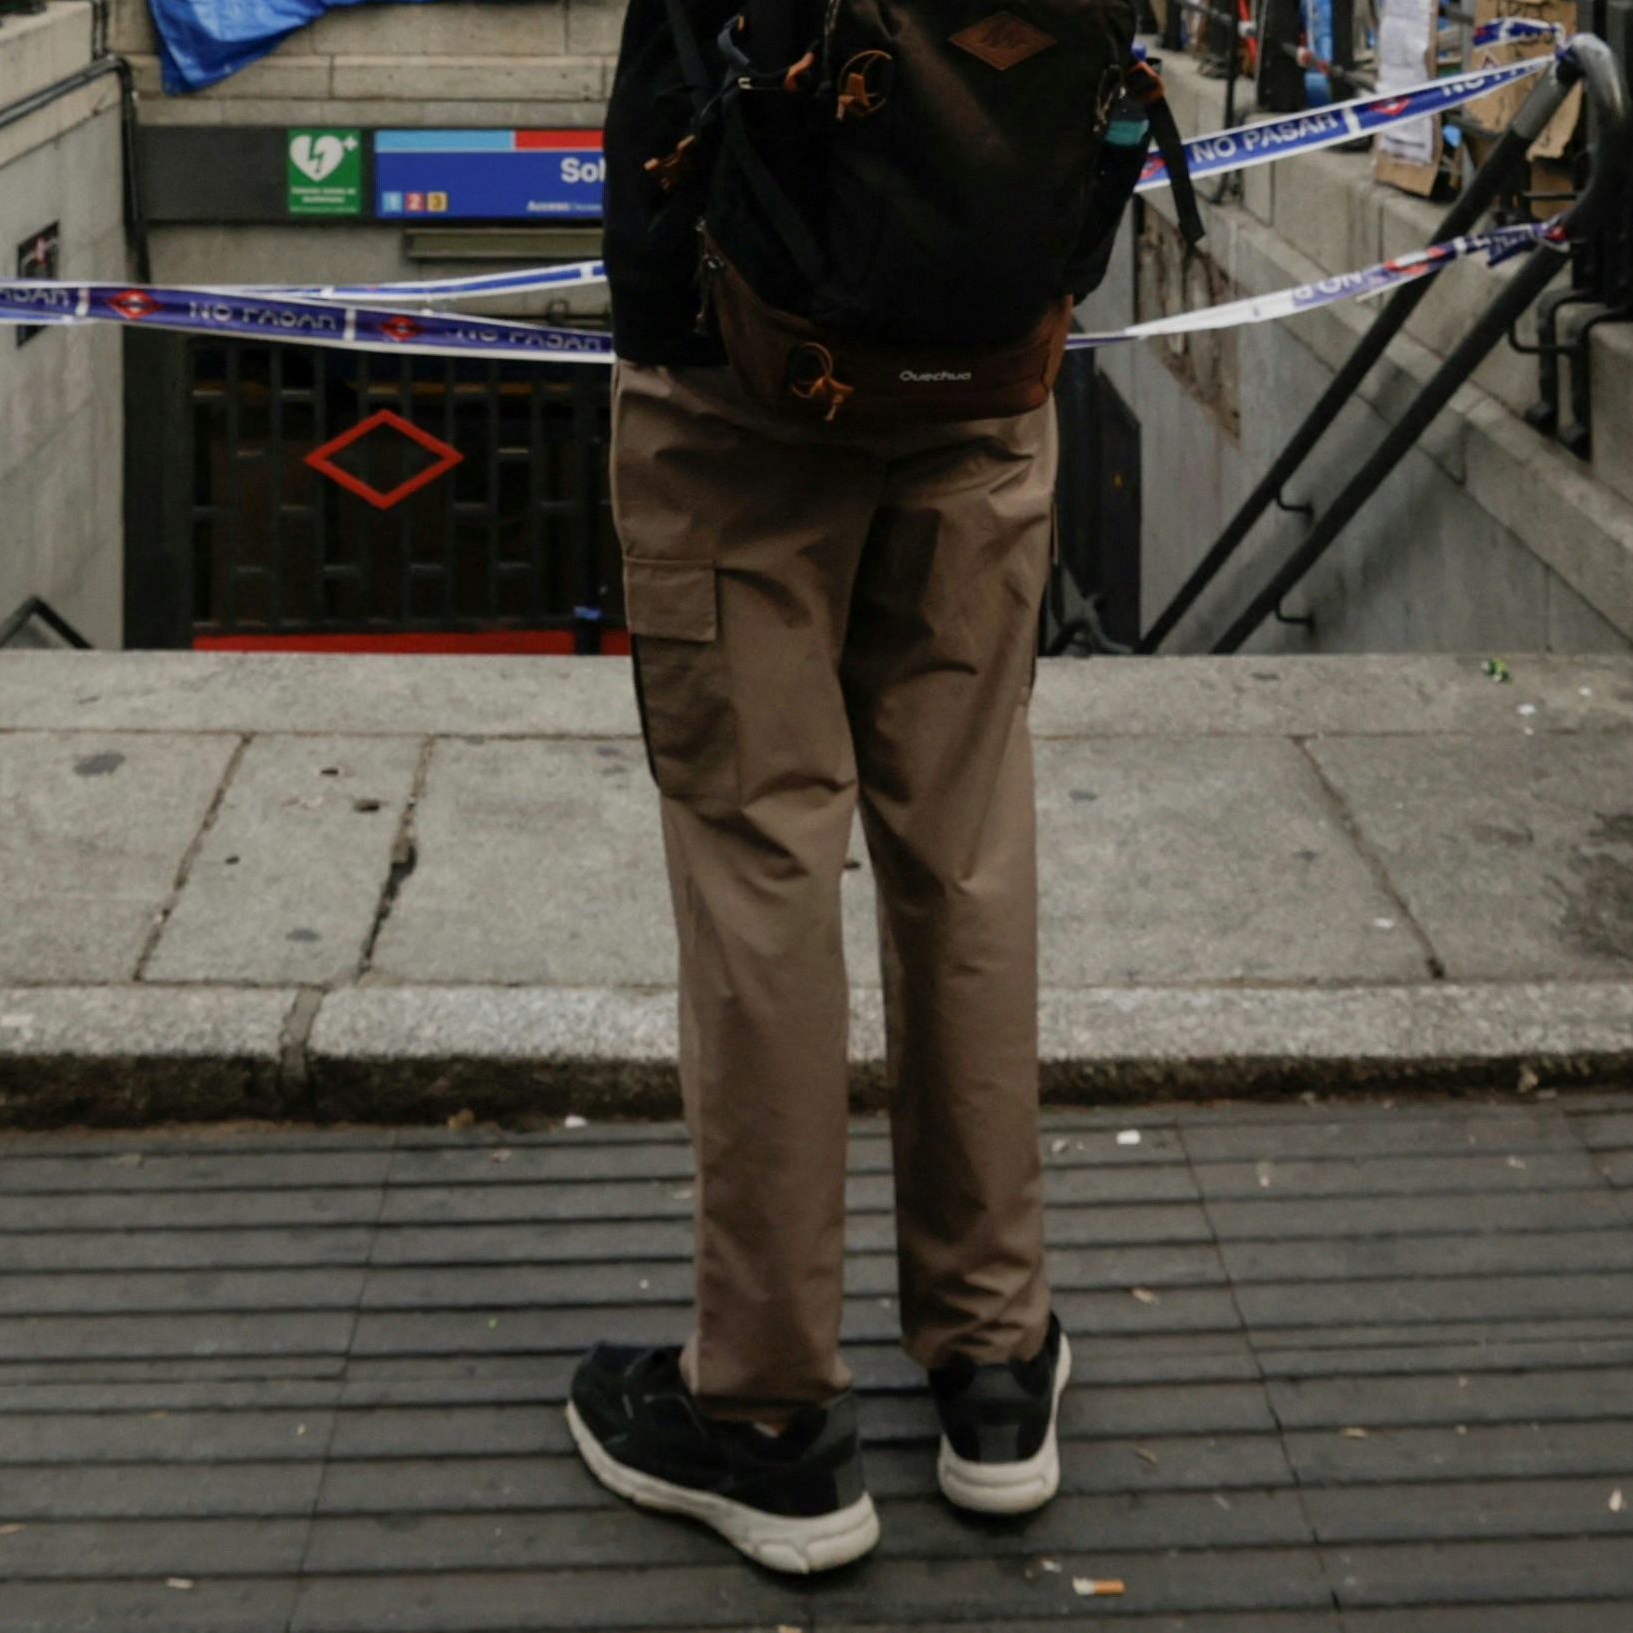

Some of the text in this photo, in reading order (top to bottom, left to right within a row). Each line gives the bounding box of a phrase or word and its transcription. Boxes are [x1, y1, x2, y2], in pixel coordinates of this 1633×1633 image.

[1191, 112, 1339, 165] NO PASAR
[560, 156, 607, 184] Sol
[898, 369, 973, 383] Quechua
